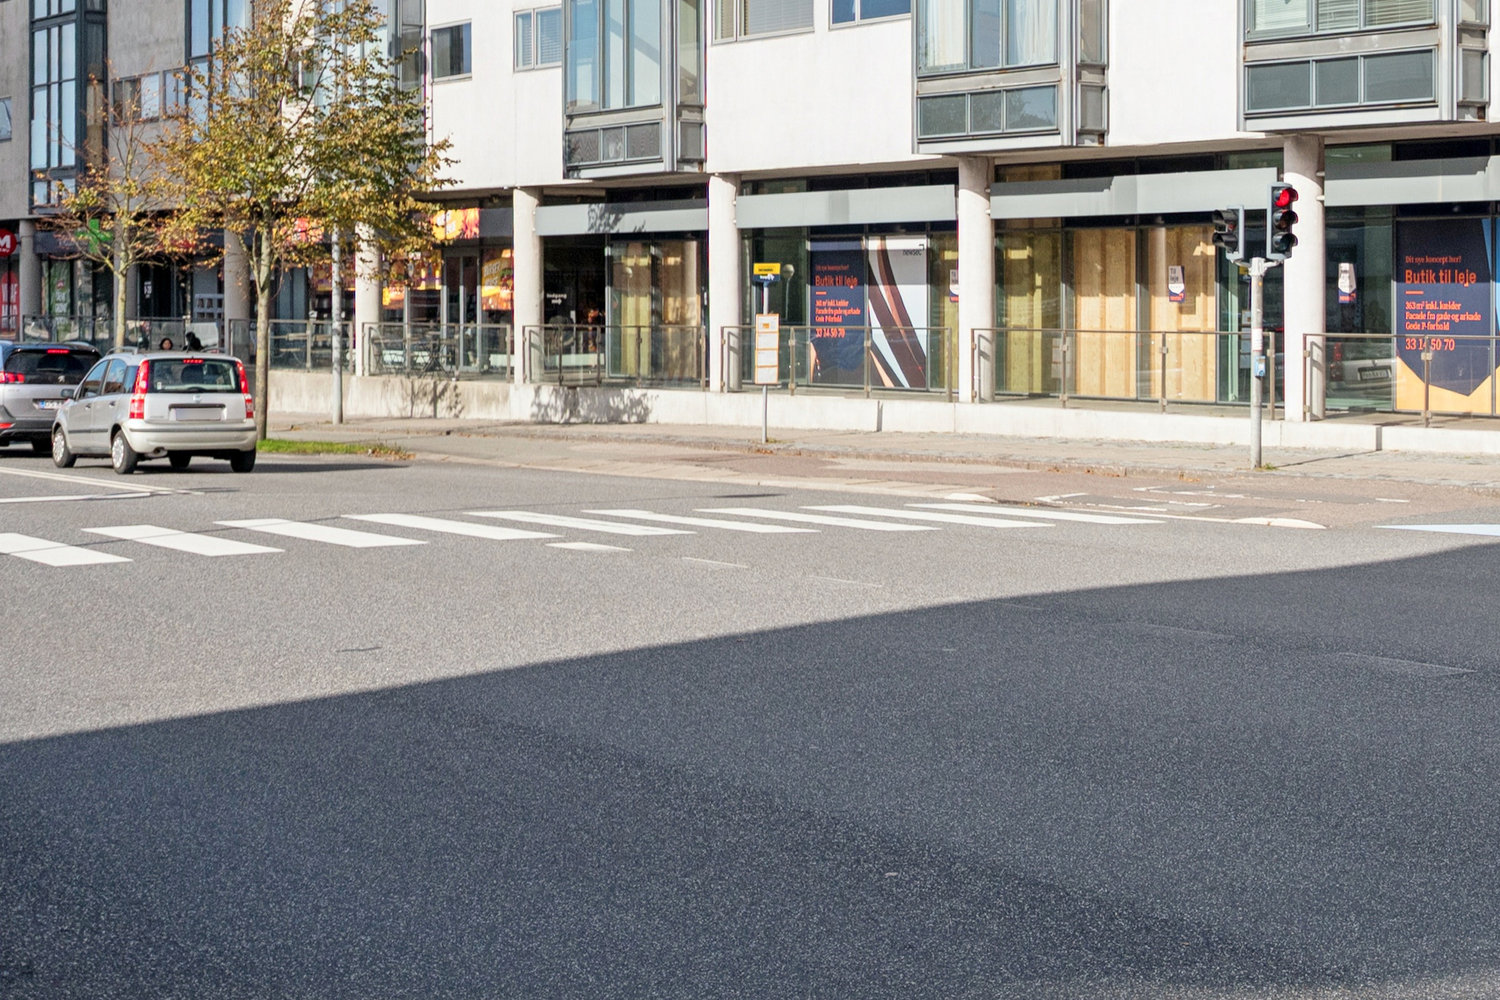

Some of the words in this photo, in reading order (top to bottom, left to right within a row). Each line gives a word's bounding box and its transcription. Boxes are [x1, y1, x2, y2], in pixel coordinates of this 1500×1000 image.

[815, 275, 834, 286] Butik
[835, 275, 843, 286] til
[1405, 269, 1436, 284] Butik
[1438, 269, 1451, 284] til
[1454, 268, 1477, 287] leje
[1405, 338, 1416, 350] 33
[1430, 338, 1442, 351] 50
[1443, 338, 1455, 351] 70
